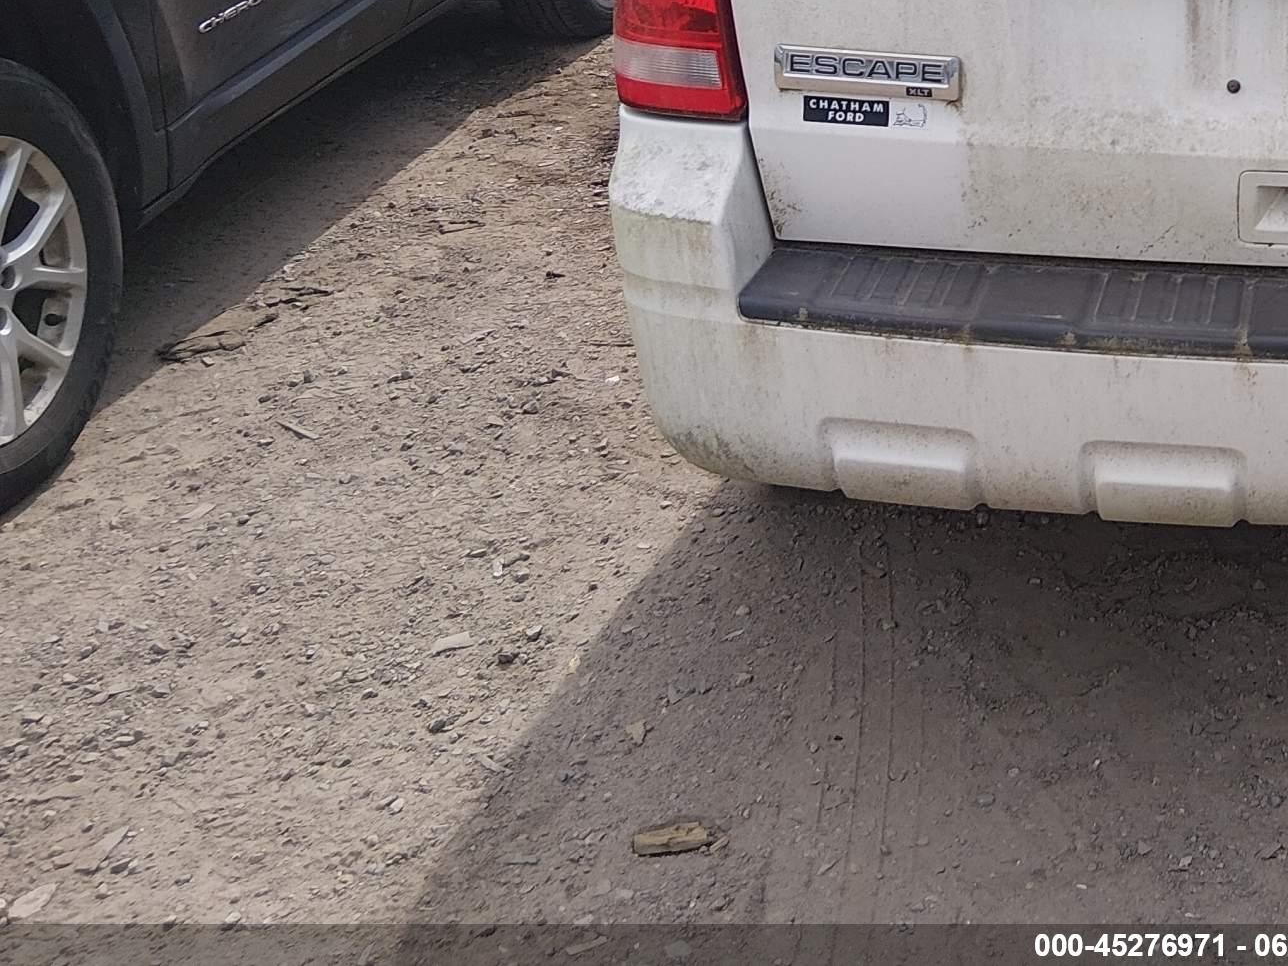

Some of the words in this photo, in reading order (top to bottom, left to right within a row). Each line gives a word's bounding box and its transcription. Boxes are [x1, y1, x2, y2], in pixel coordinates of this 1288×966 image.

[789, 54, 943, 82] ESCAPE
[908, 88, 930, 96] XLT
[809, 99, 884, 113] CHATHAM
[827, 111, 865, 122] FORD
